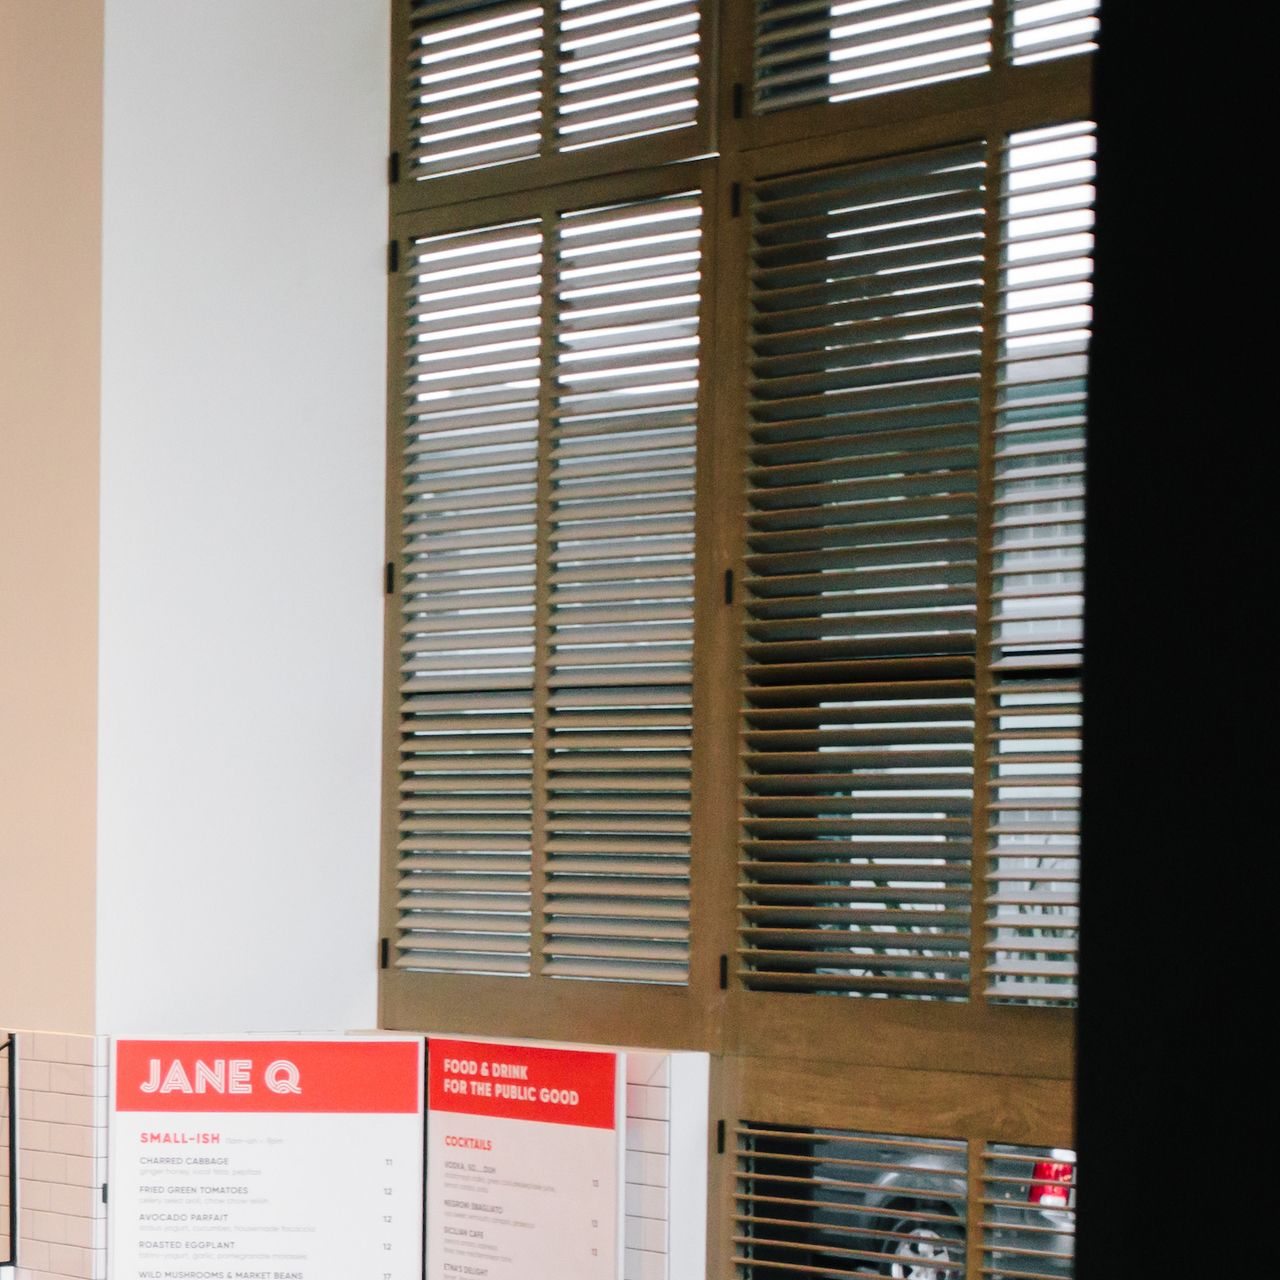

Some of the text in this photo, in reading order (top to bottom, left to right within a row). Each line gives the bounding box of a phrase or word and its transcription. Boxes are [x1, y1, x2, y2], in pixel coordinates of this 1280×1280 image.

[444, 1058, 528, 1080] FOOD & DRINK
[140, 1059, 302, 1094] JANE Q
[444, 1078, 579, 1106] FOR THE PUBLIC GOOD
[140, 1132, 220, 1144] SMALL-ISH
[445, 1135, 492, 1151] COCKTAILS
[140, 1157, 184, 1165] CHARRED
[185, 1157, 228, 1165] CABBAGE
[139, 1186, 165, 1194] FRIED
[167, 1186, 197, 1194] GREEN
[200, 1186, 249, 1195] TOMATOES
[139, 1213, 188, 1222] AVOCADO
[190, 1214, 228, 1222] PARFAIT
[139, 1241, 182, 1249] ROASTED
[185, 1241, 235, 1249] EGGPLANT
[139, 1271, 162, 1279] WILD
[164, 1271, 224, 1279] MUSHROOMS
[235, 1272, 271, 1280] MARKET
[274, 1272, 303, 1280] BEANS
